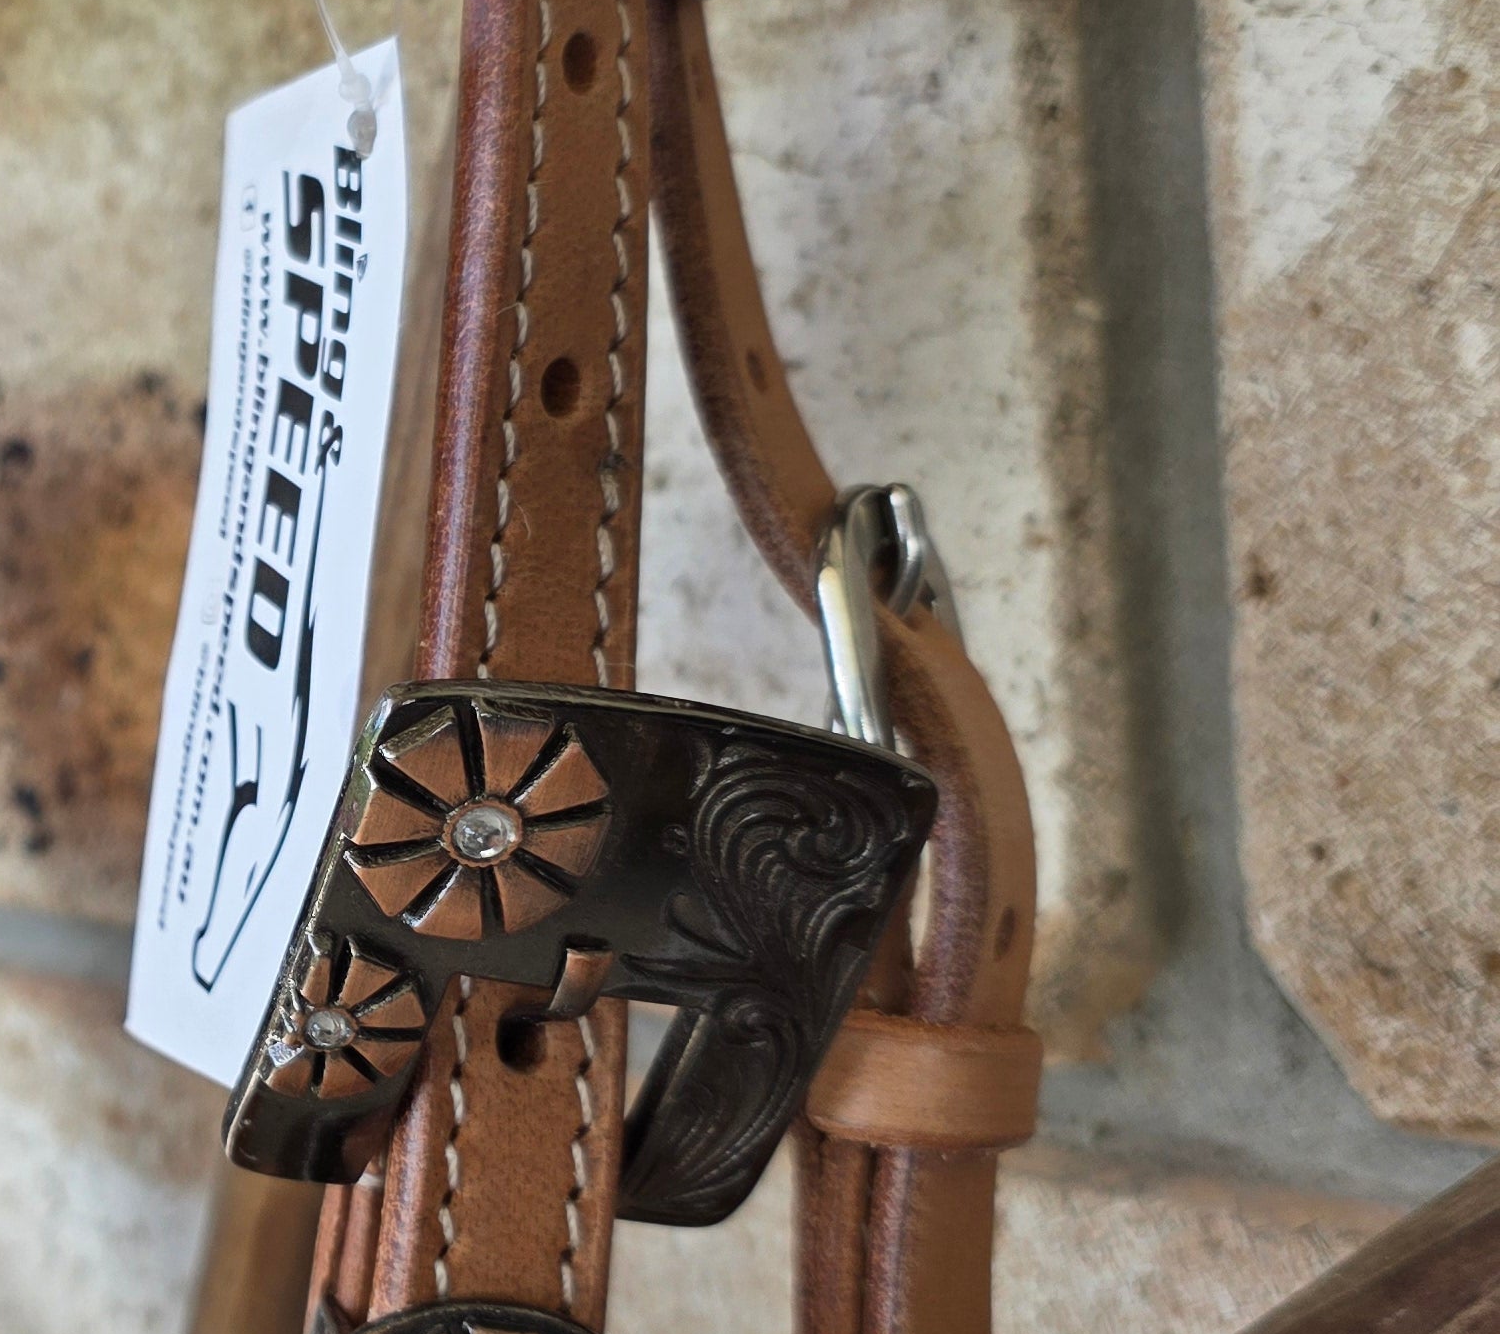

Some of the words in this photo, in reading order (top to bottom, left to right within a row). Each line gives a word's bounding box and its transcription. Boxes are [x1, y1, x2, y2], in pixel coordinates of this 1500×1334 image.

[244, 170, 326, 670] SPEED
[316, 409, 344, 475] &
[320, 145, 366, 401] Bling
[177, 212, 271, 904] www.blingandspeed.com.au
